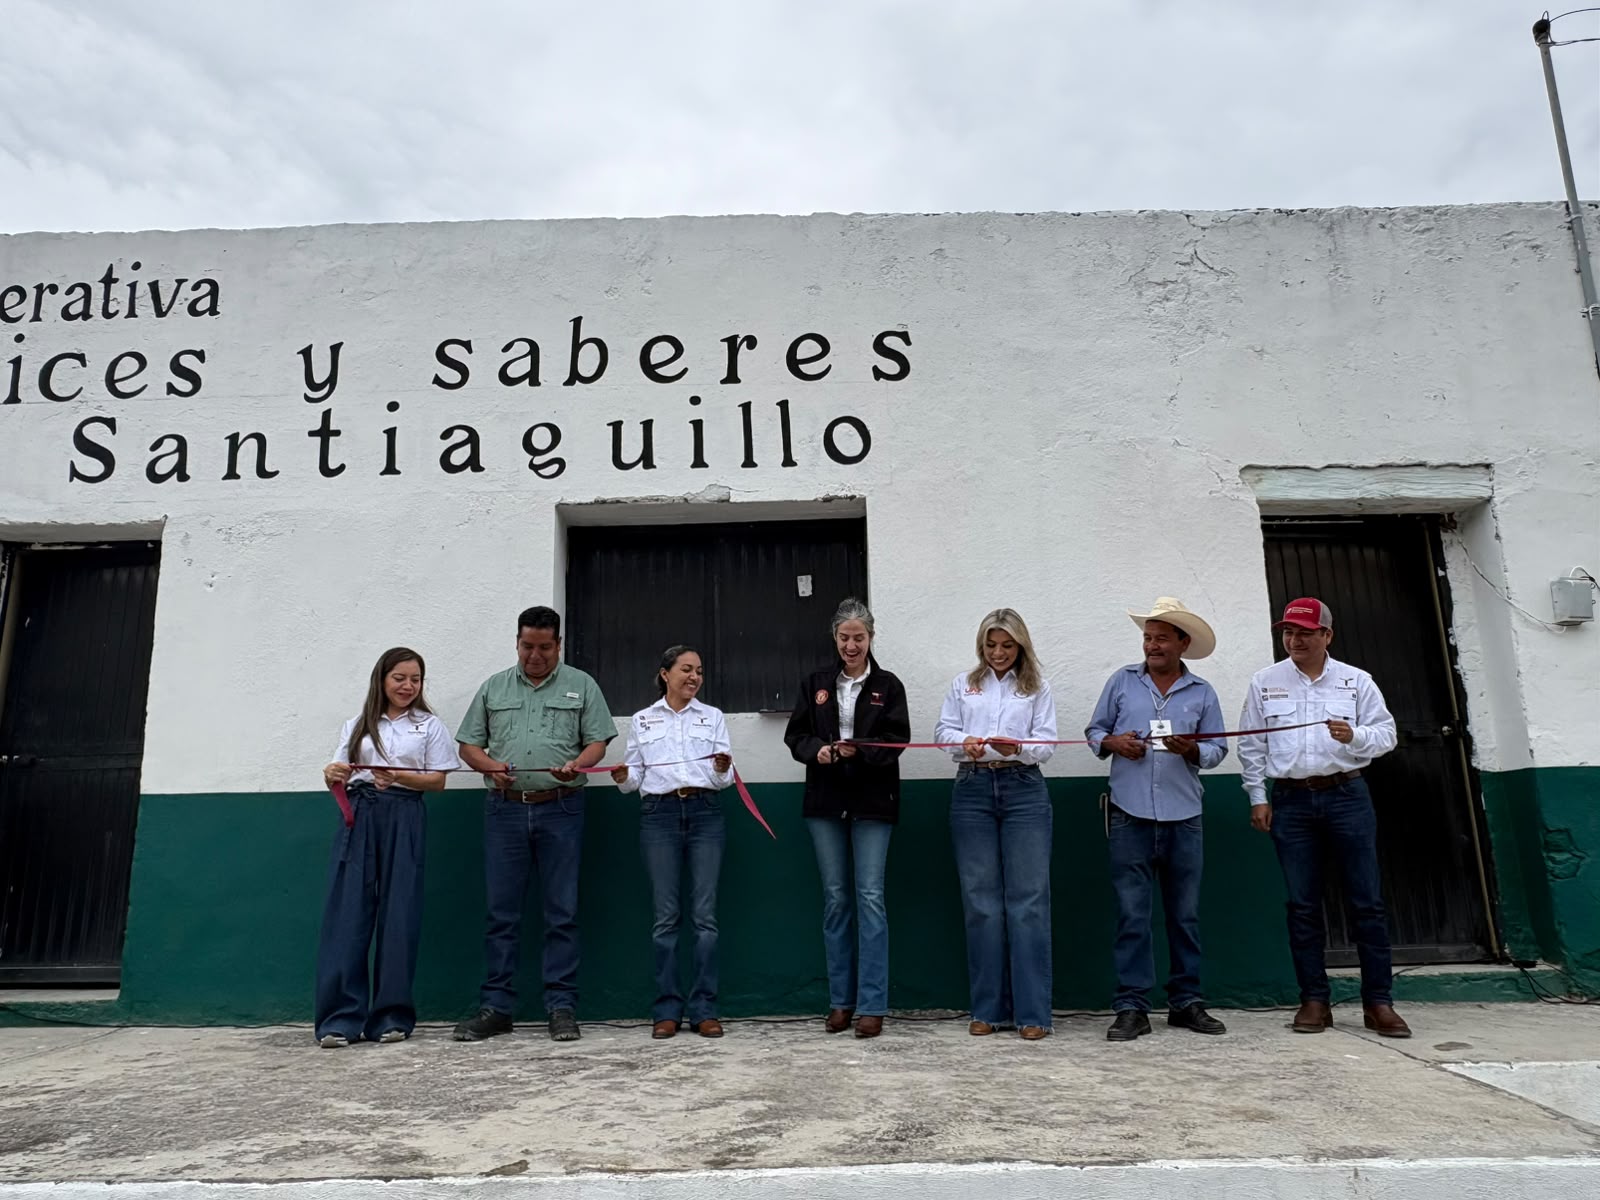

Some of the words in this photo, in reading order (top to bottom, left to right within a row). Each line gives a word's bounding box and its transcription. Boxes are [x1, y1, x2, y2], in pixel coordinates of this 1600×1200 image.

[0, 260, 221, 324] erativa
[2, 333, 206, 405] ices
[296, 341, 344, 404] y
[431, 315, 913, 391] saberes
[69, 395, 872, 484] Santiaguillo
